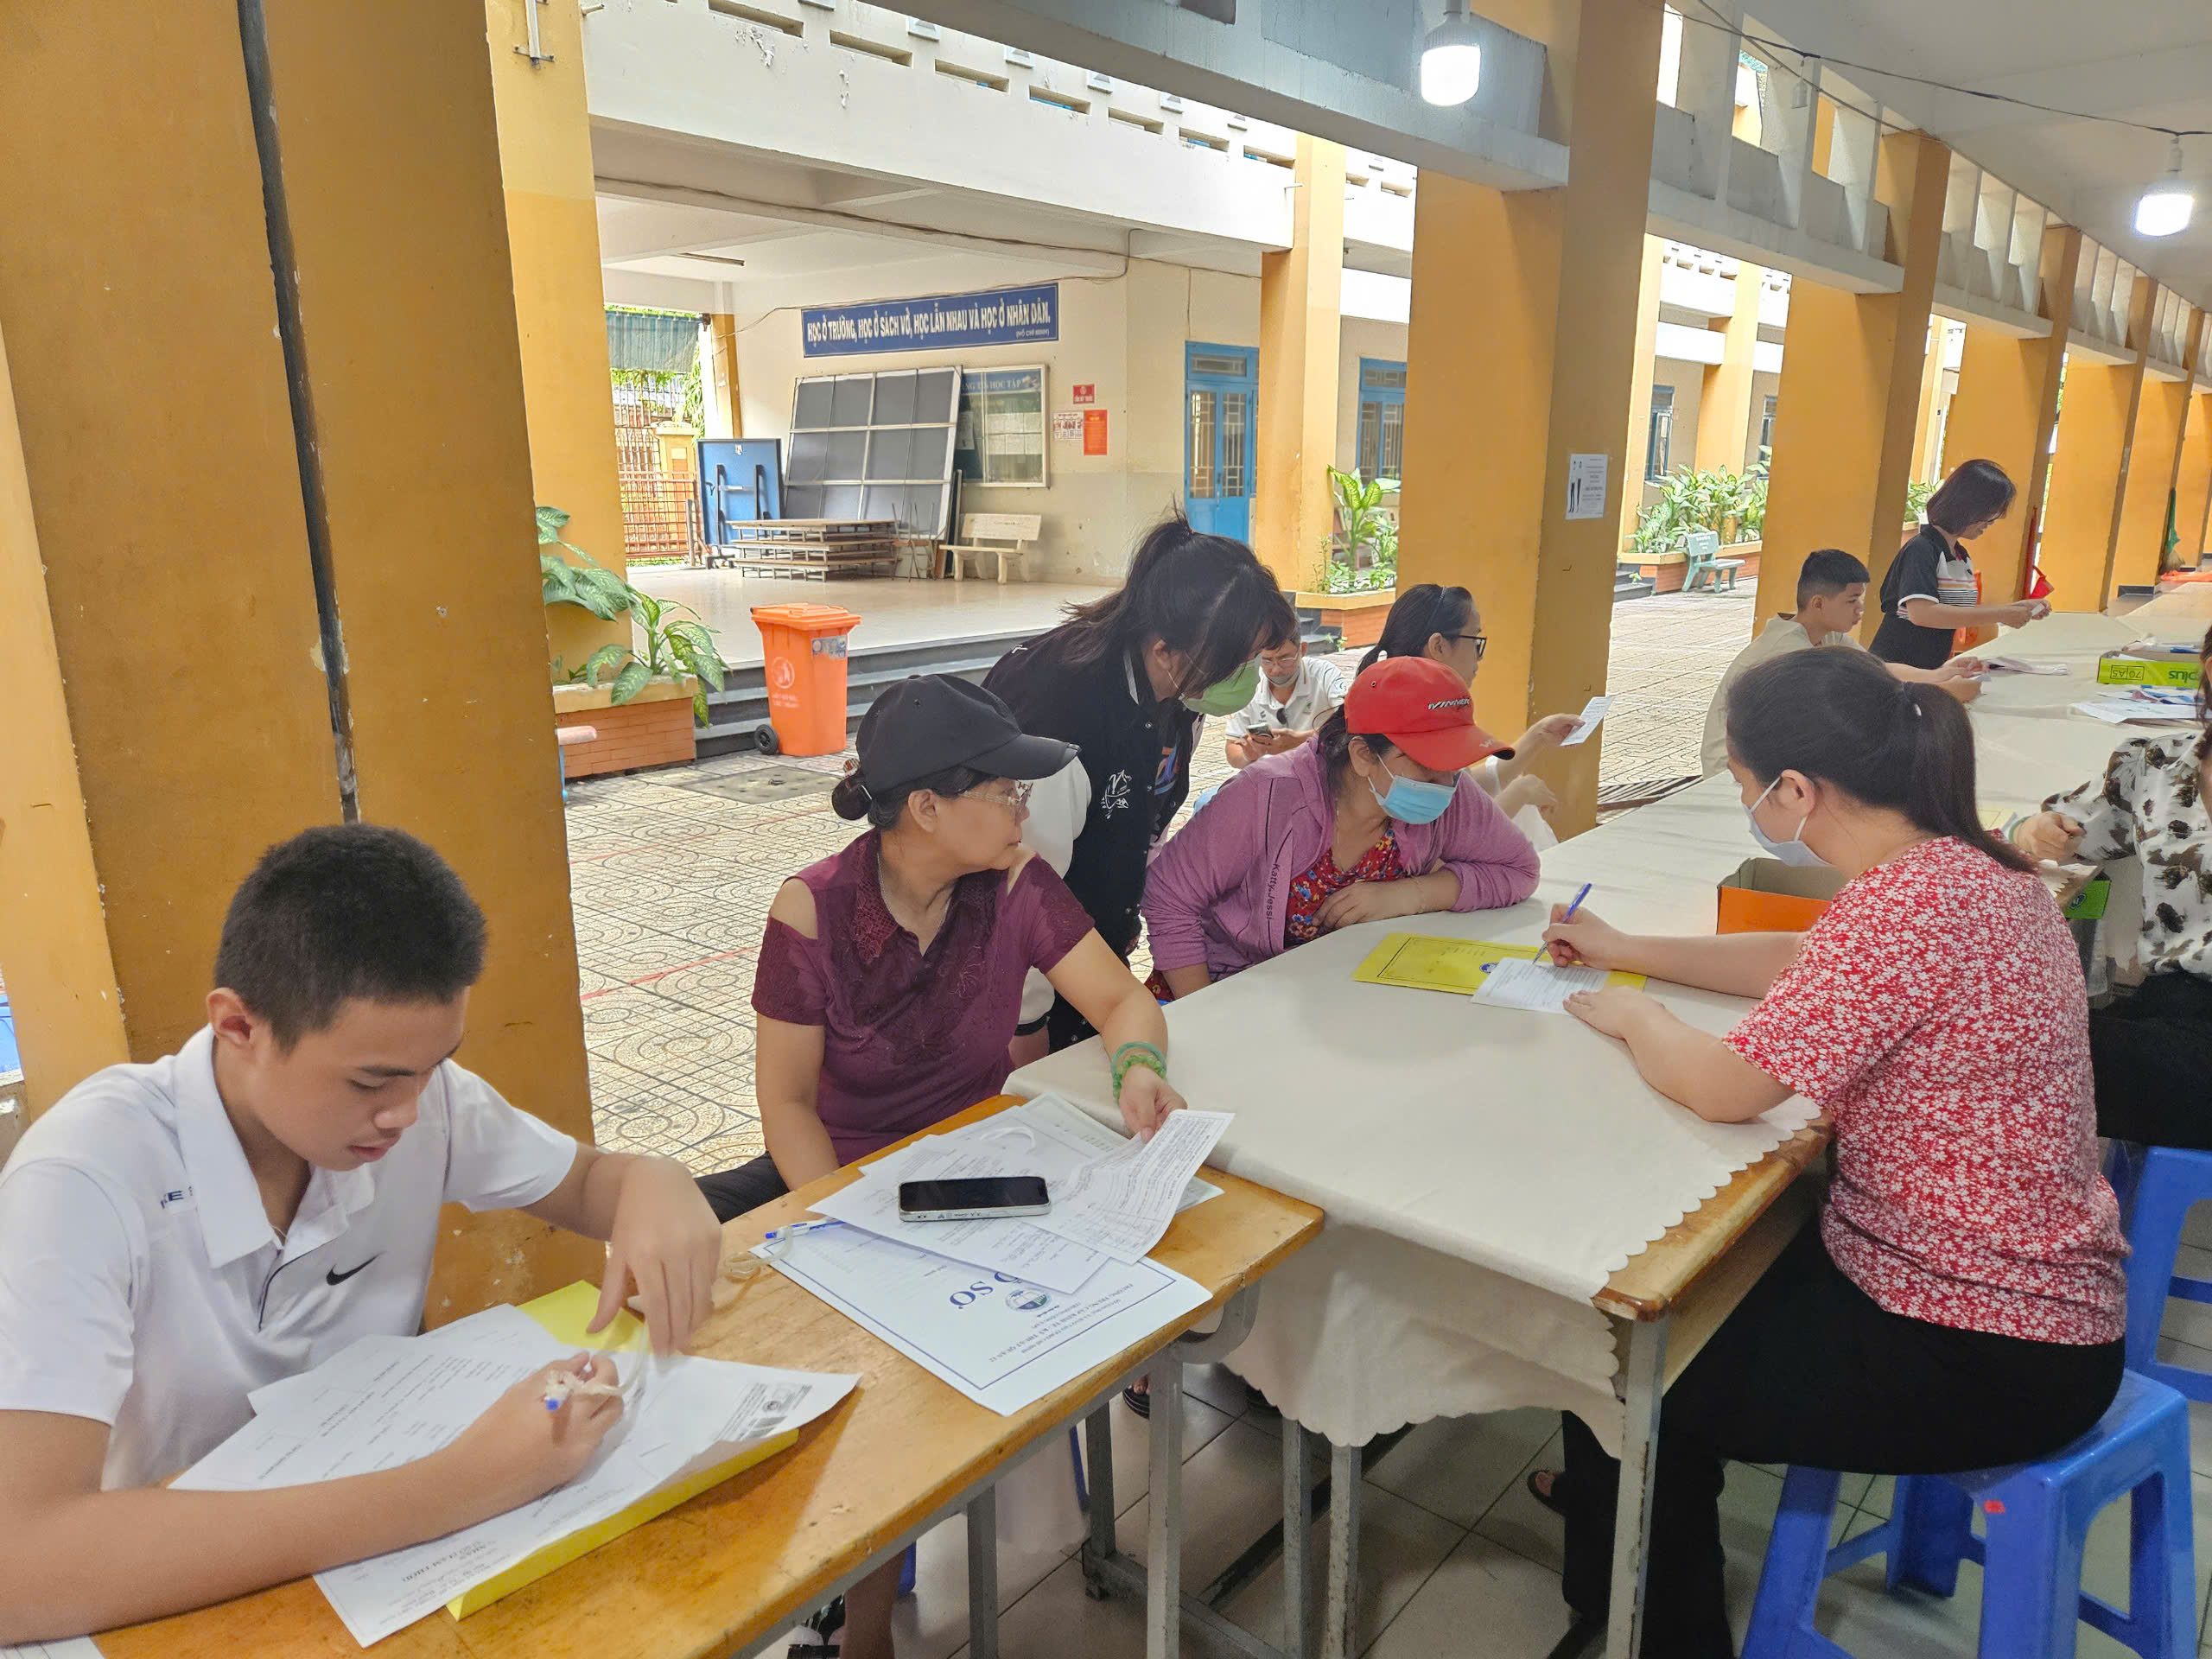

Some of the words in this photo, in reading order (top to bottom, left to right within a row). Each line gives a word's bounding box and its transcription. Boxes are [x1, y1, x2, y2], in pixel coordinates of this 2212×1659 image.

[808, 322, 822, 347] HỌC
[858, 318, 873, 344] HỌC
[880, 311, 899, 337] SÁCH
[913, 313, 929, 340] HỌC
[946, 309, 968, 332] NHAU
[969, 302, 980, 330] VÀ
[981, 306, 997, 335] HỌC
[1007, 298, 1030, 327] NHÂN
[1031, 297, 1051, 325] DÂN.
[2112, 669, 2126, 677] A5
[2128, 670, 2142, 678] 70
